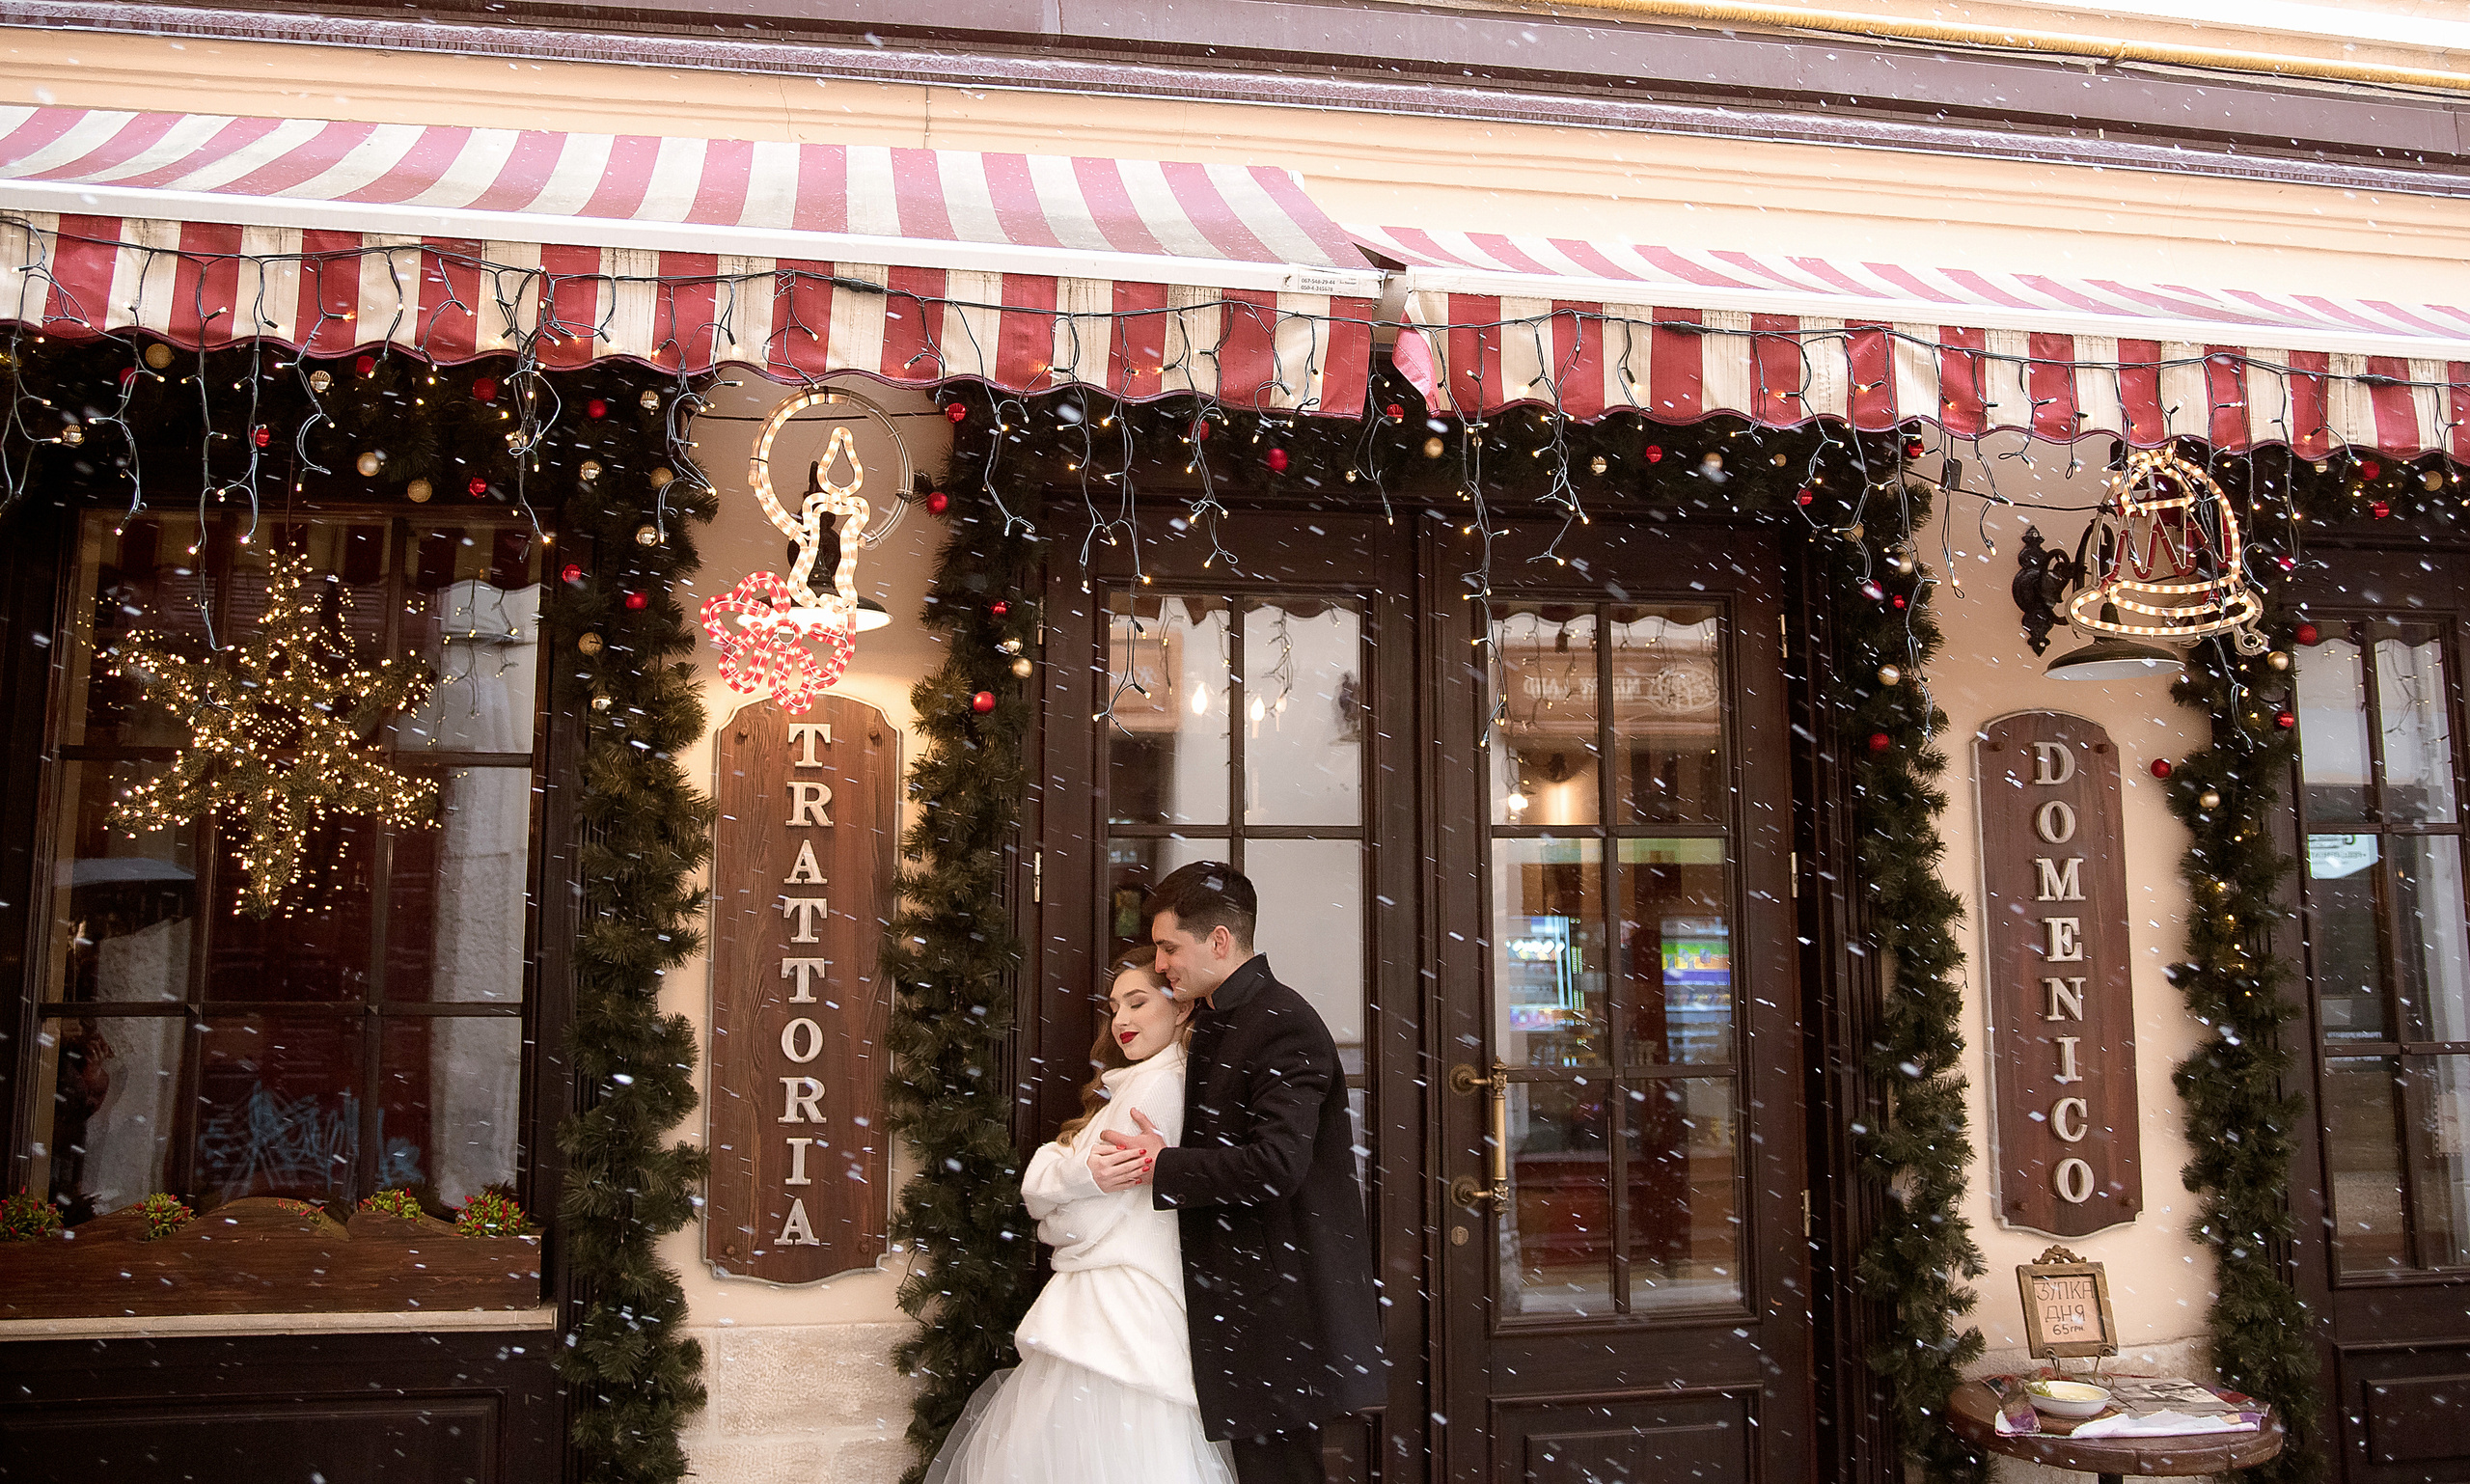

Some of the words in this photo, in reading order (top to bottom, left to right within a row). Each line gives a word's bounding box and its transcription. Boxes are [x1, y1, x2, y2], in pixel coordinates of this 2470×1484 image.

[774, 724, 834, 1246] TRATTORIA
[2033, 741, 2095, 1204] DOMENICO
[2034, 1281, 2094, 1301] ЗУПКА
[2045, 1305, 2085, 1323] ДНЯ
